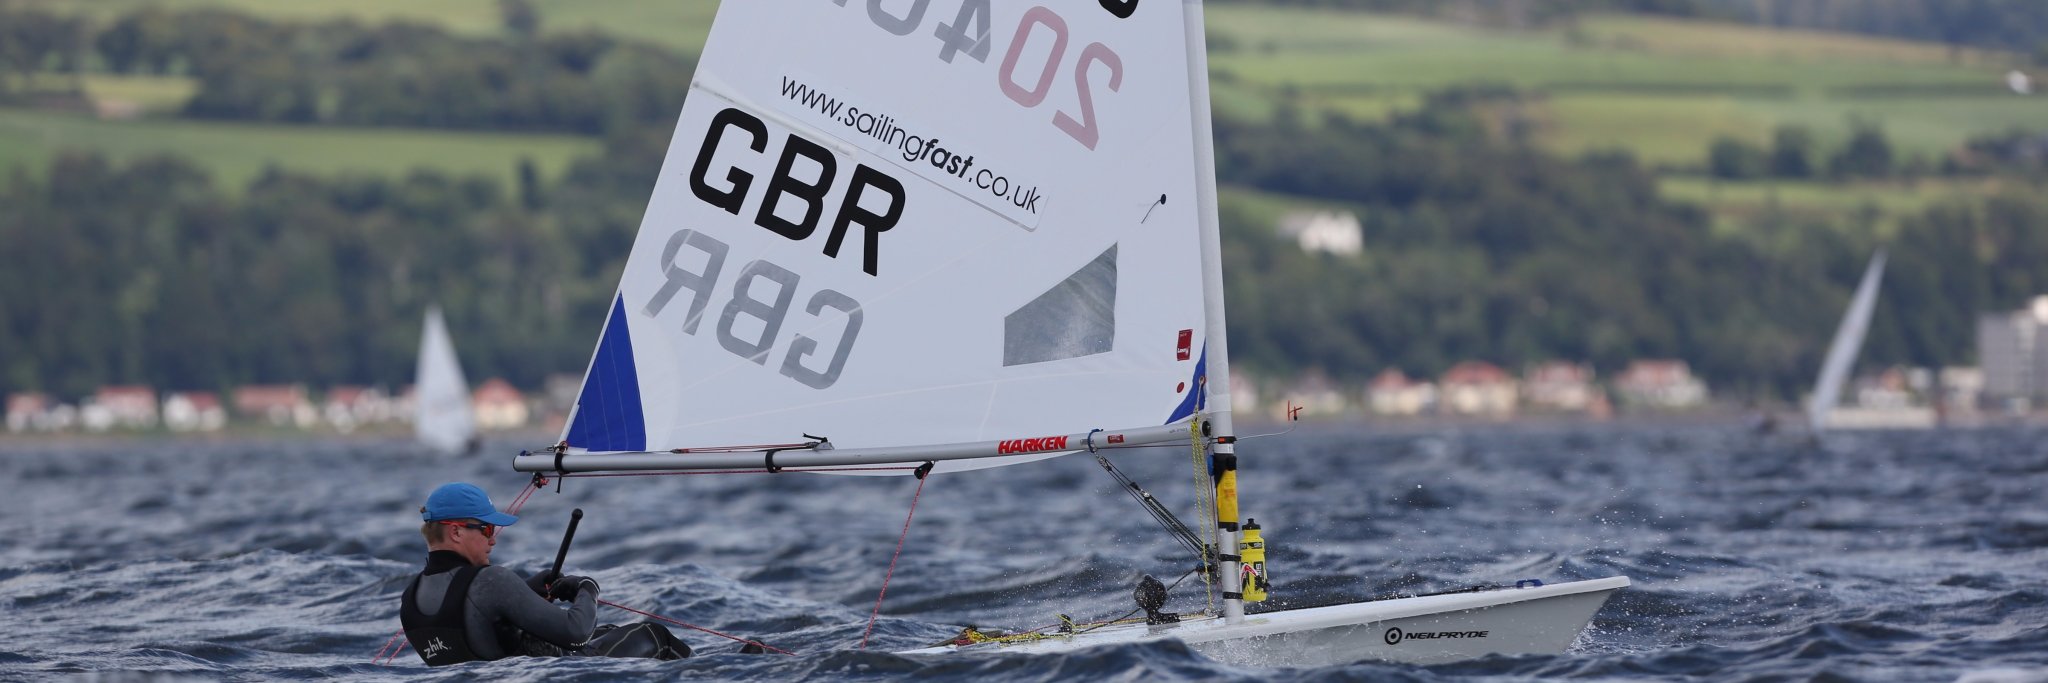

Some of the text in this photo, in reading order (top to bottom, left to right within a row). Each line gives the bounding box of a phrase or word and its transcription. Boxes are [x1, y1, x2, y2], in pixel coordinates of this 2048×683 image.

[781, 75, 1041, 214] www.sailingfast.co.uk
[689, 107, 906, 277] GBR
[998, 436, 1068, 454] HARKEN
[1404, 630, 1489, 640] NEILPRYDE
[423, 636, 448, 659] zhik
